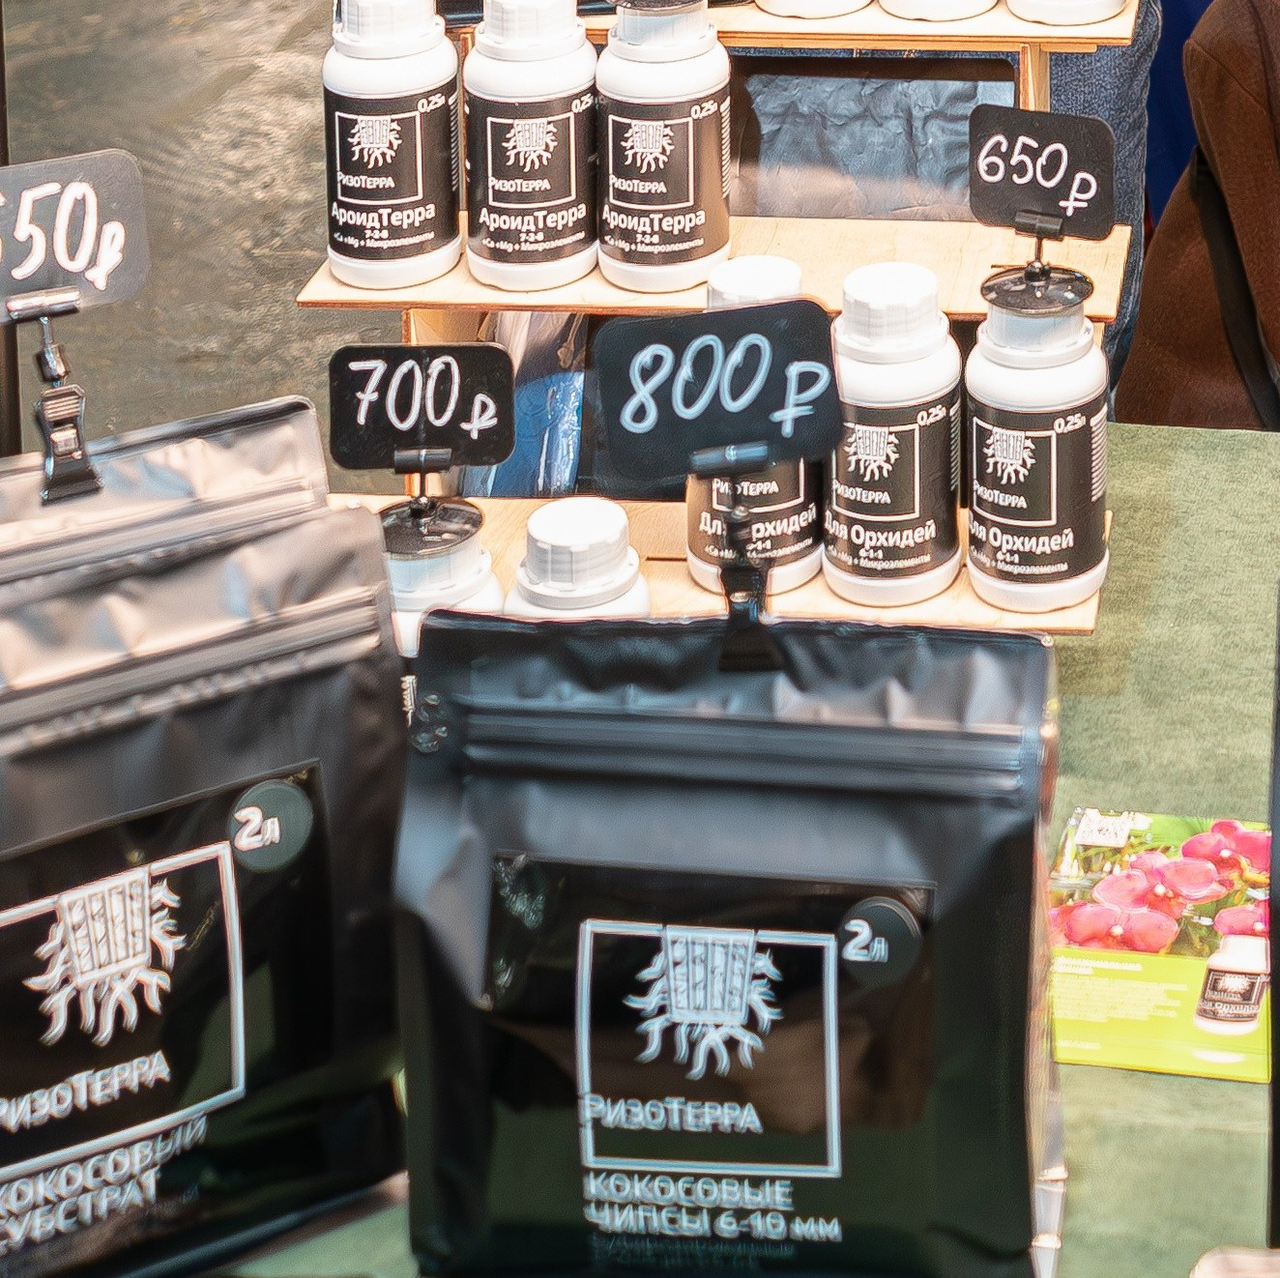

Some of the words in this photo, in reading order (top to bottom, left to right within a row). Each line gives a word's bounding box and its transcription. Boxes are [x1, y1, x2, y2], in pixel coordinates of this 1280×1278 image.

[331, 202, 436, 230] АроидТерра
[479, 203, 586, 232] АроидТерра
[602, 204, 706, 235] АроидТерра
[0, 181, 126, 291] 50₽
[699, 511, 724, 536] Дл
[823, 509, 848, 541] Для
[850, 519, 936, 551] Орхидей
[988, 527, 1075, 556] Орхидей
[232, 805, 282, 853] 2л
[841, 918, 890, 964] 2л
[584, 1171, 795, 1212] КОКОСОВЫЕ
[584, 1202, 712, 1239] ЧИПСЫ
[712, 1209, 789, 1241] 6-10
